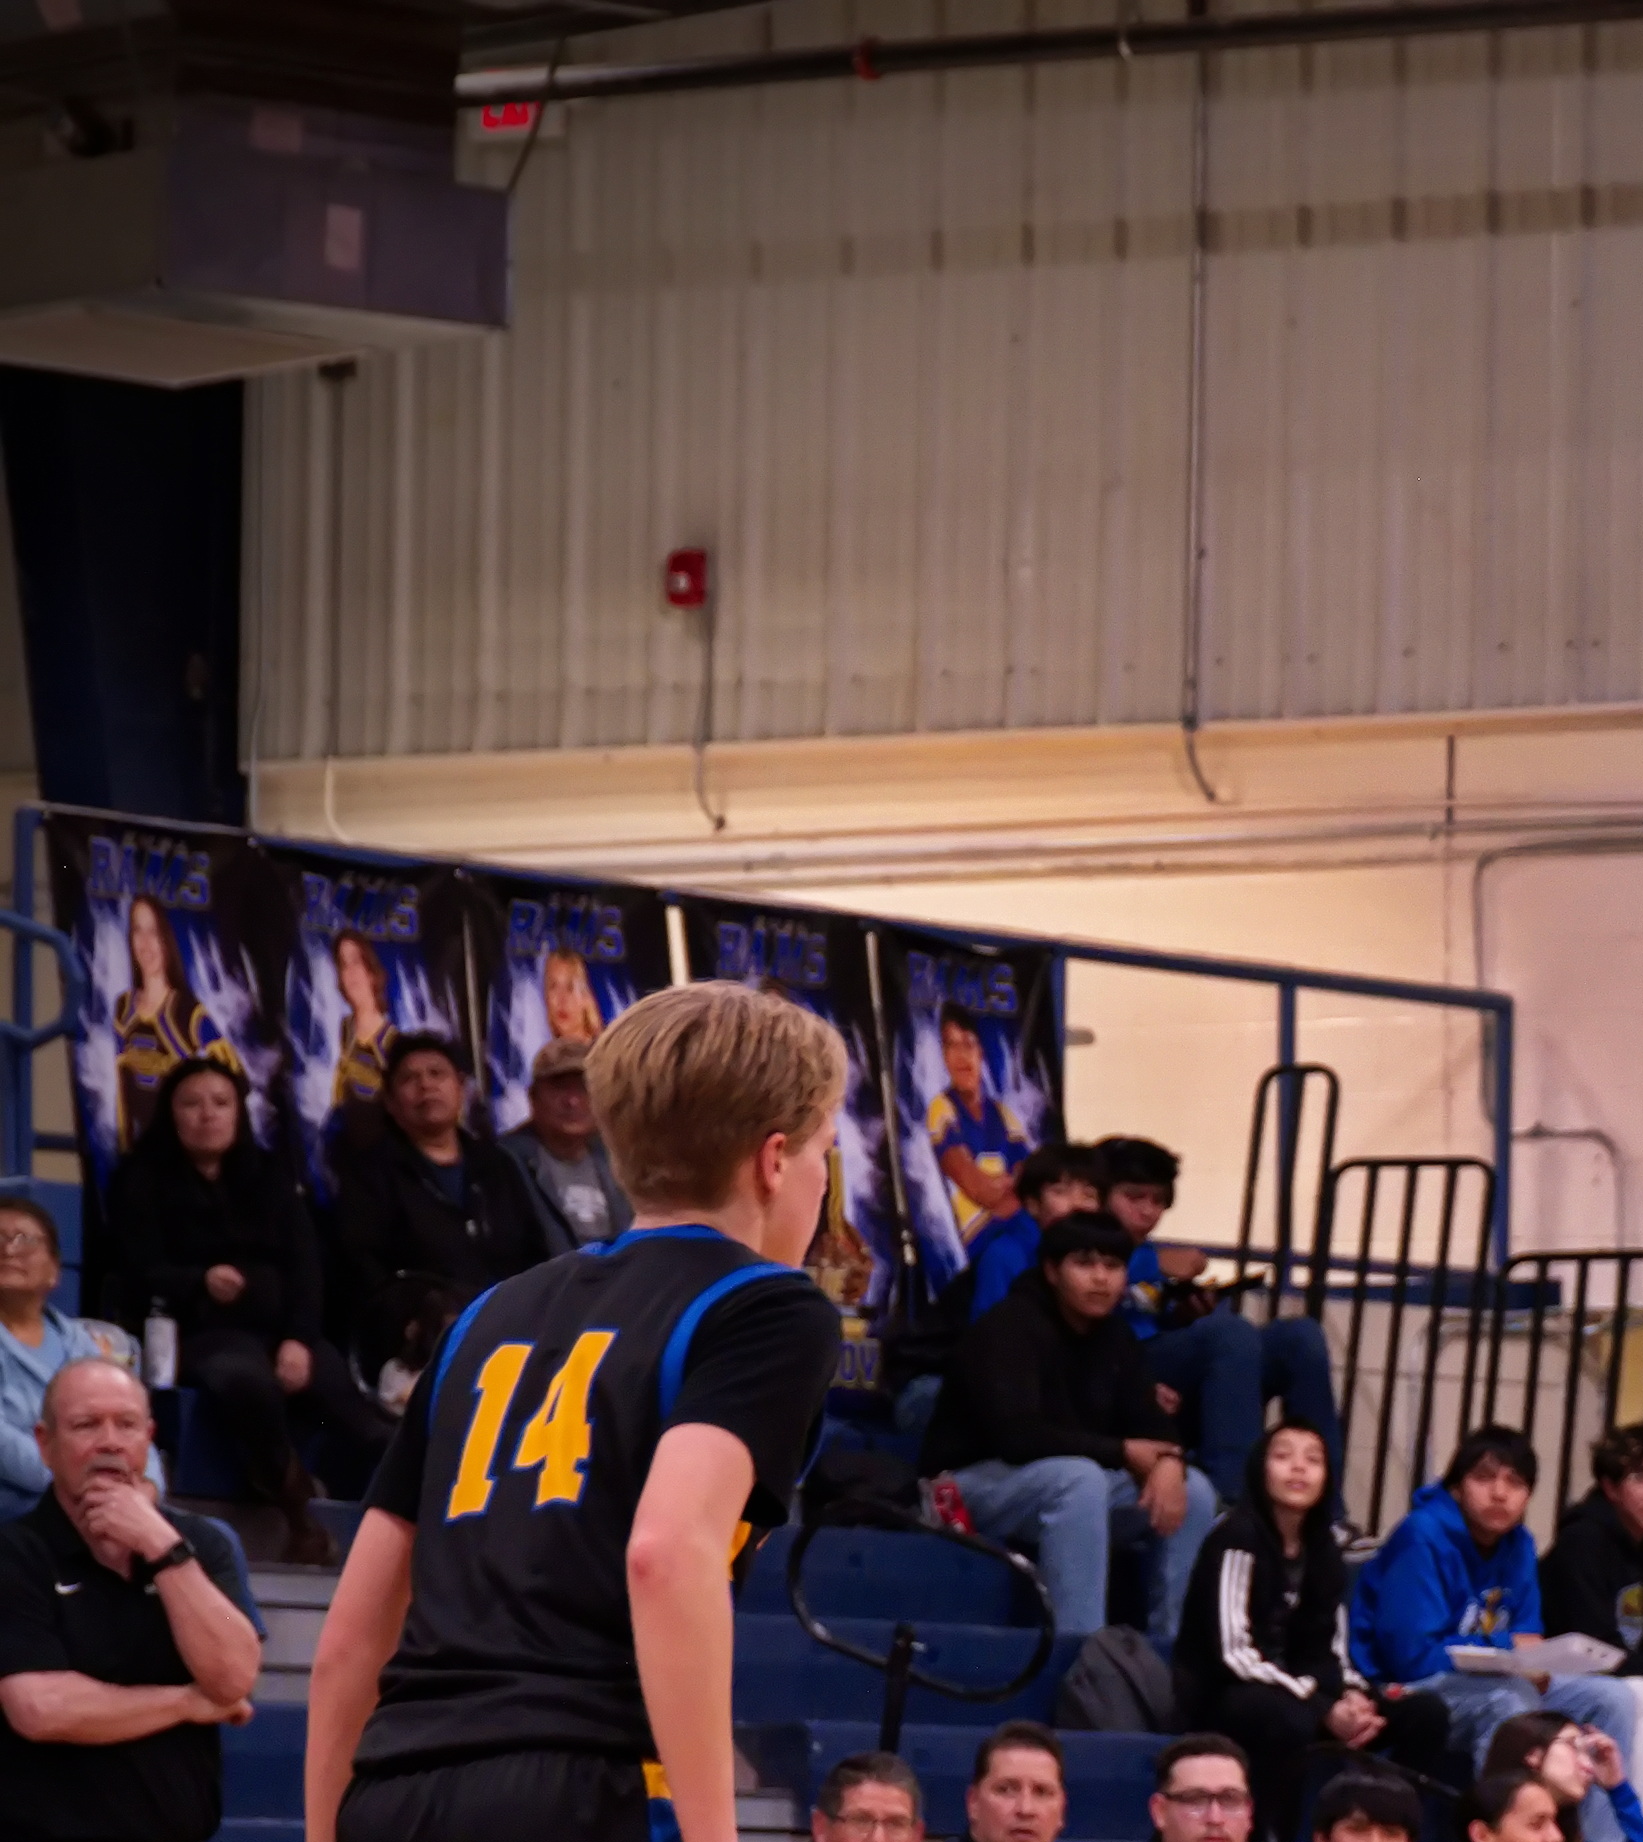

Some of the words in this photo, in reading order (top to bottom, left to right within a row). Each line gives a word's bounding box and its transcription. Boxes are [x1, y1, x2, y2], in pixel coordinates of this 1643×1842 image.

[88, 834, 212, 908] RAMS
[301, 871, 420, 940] RAMS
[508, 897, 625, 961] RAMS
[716, 920, 828, 986] RAMS
[906, 951, 1019, 1014] RAMS
[445, 1328, 620, 1523] 14
